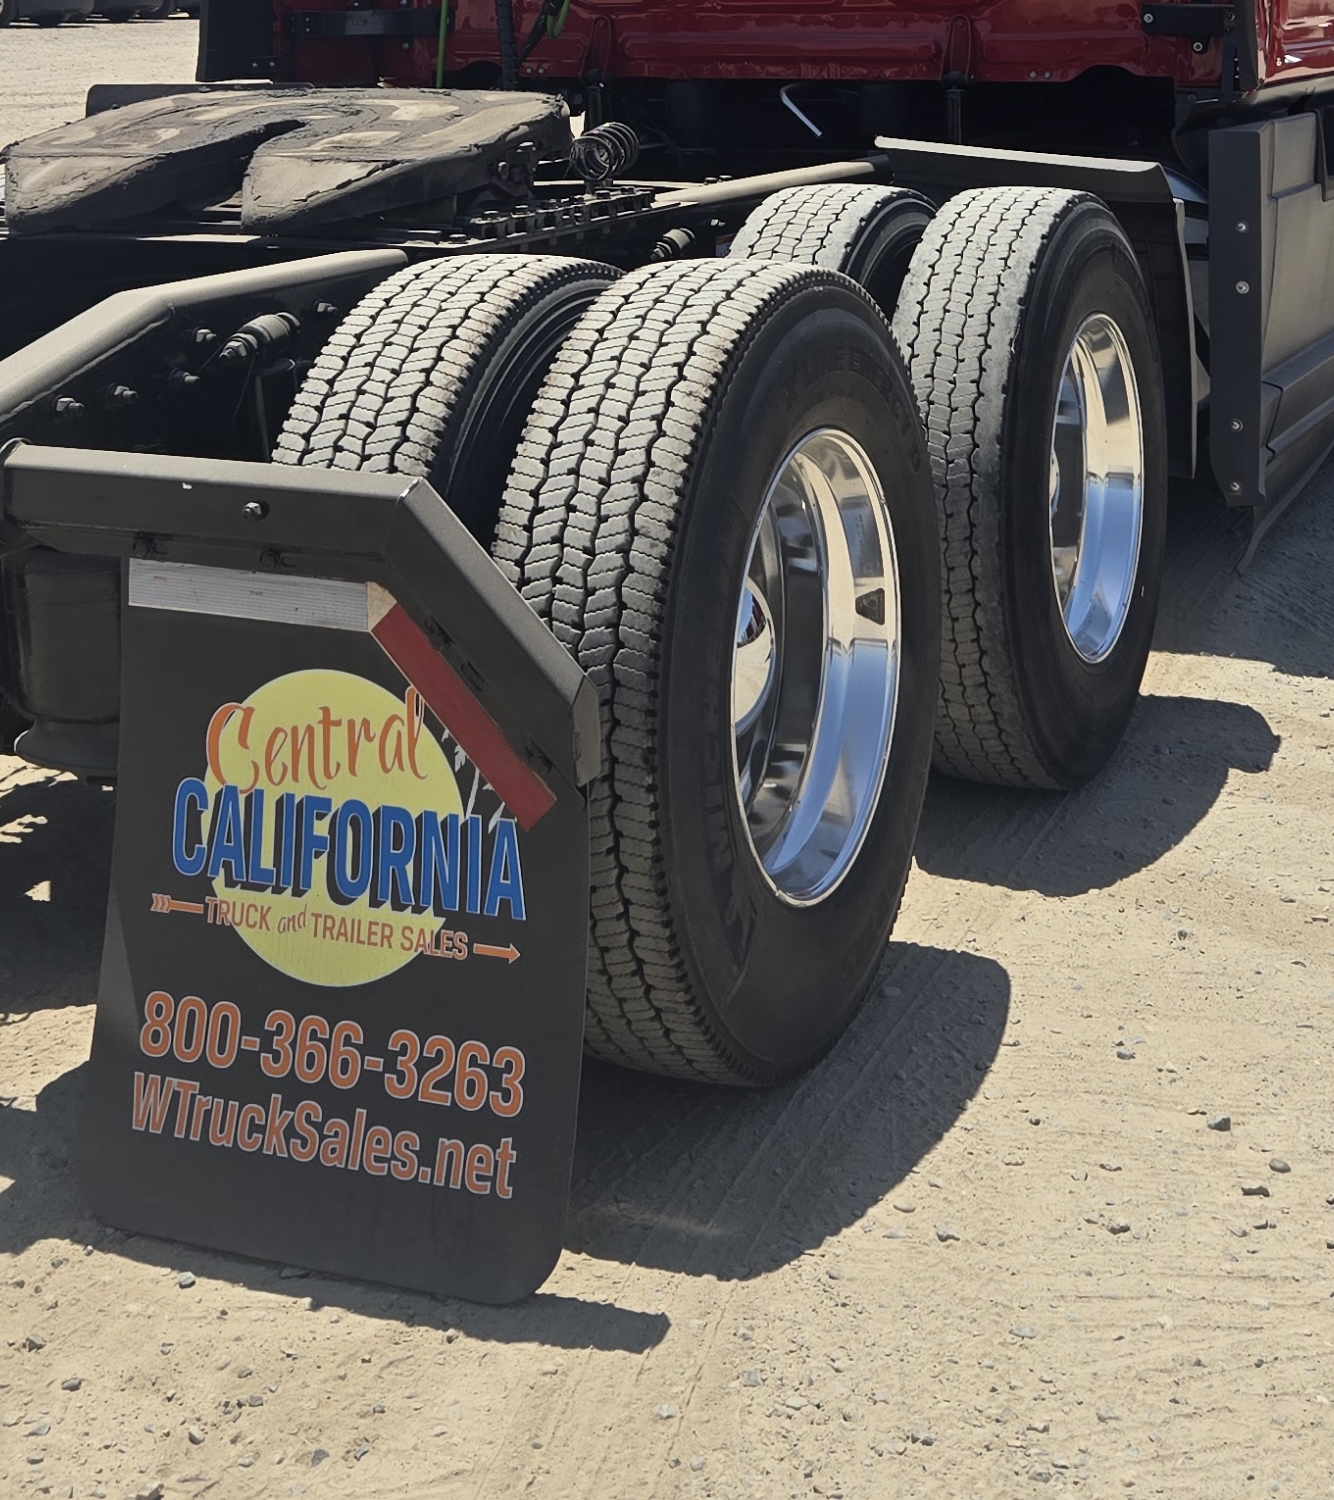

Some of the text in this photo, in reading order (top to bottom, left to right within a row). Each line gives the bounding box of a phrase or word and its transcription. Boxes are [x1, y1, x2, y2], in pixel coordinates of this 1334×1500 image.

[206, 685, 428, 792] Central
[171, 777, 527, 921] CALIFORNIA
[205, 897, 469, 961] TRUCK and TRAILER SALES
[139, 991, 526, 1117] 800-366-3263
[131, 1070, 517, 1200] WTruckSales.net
